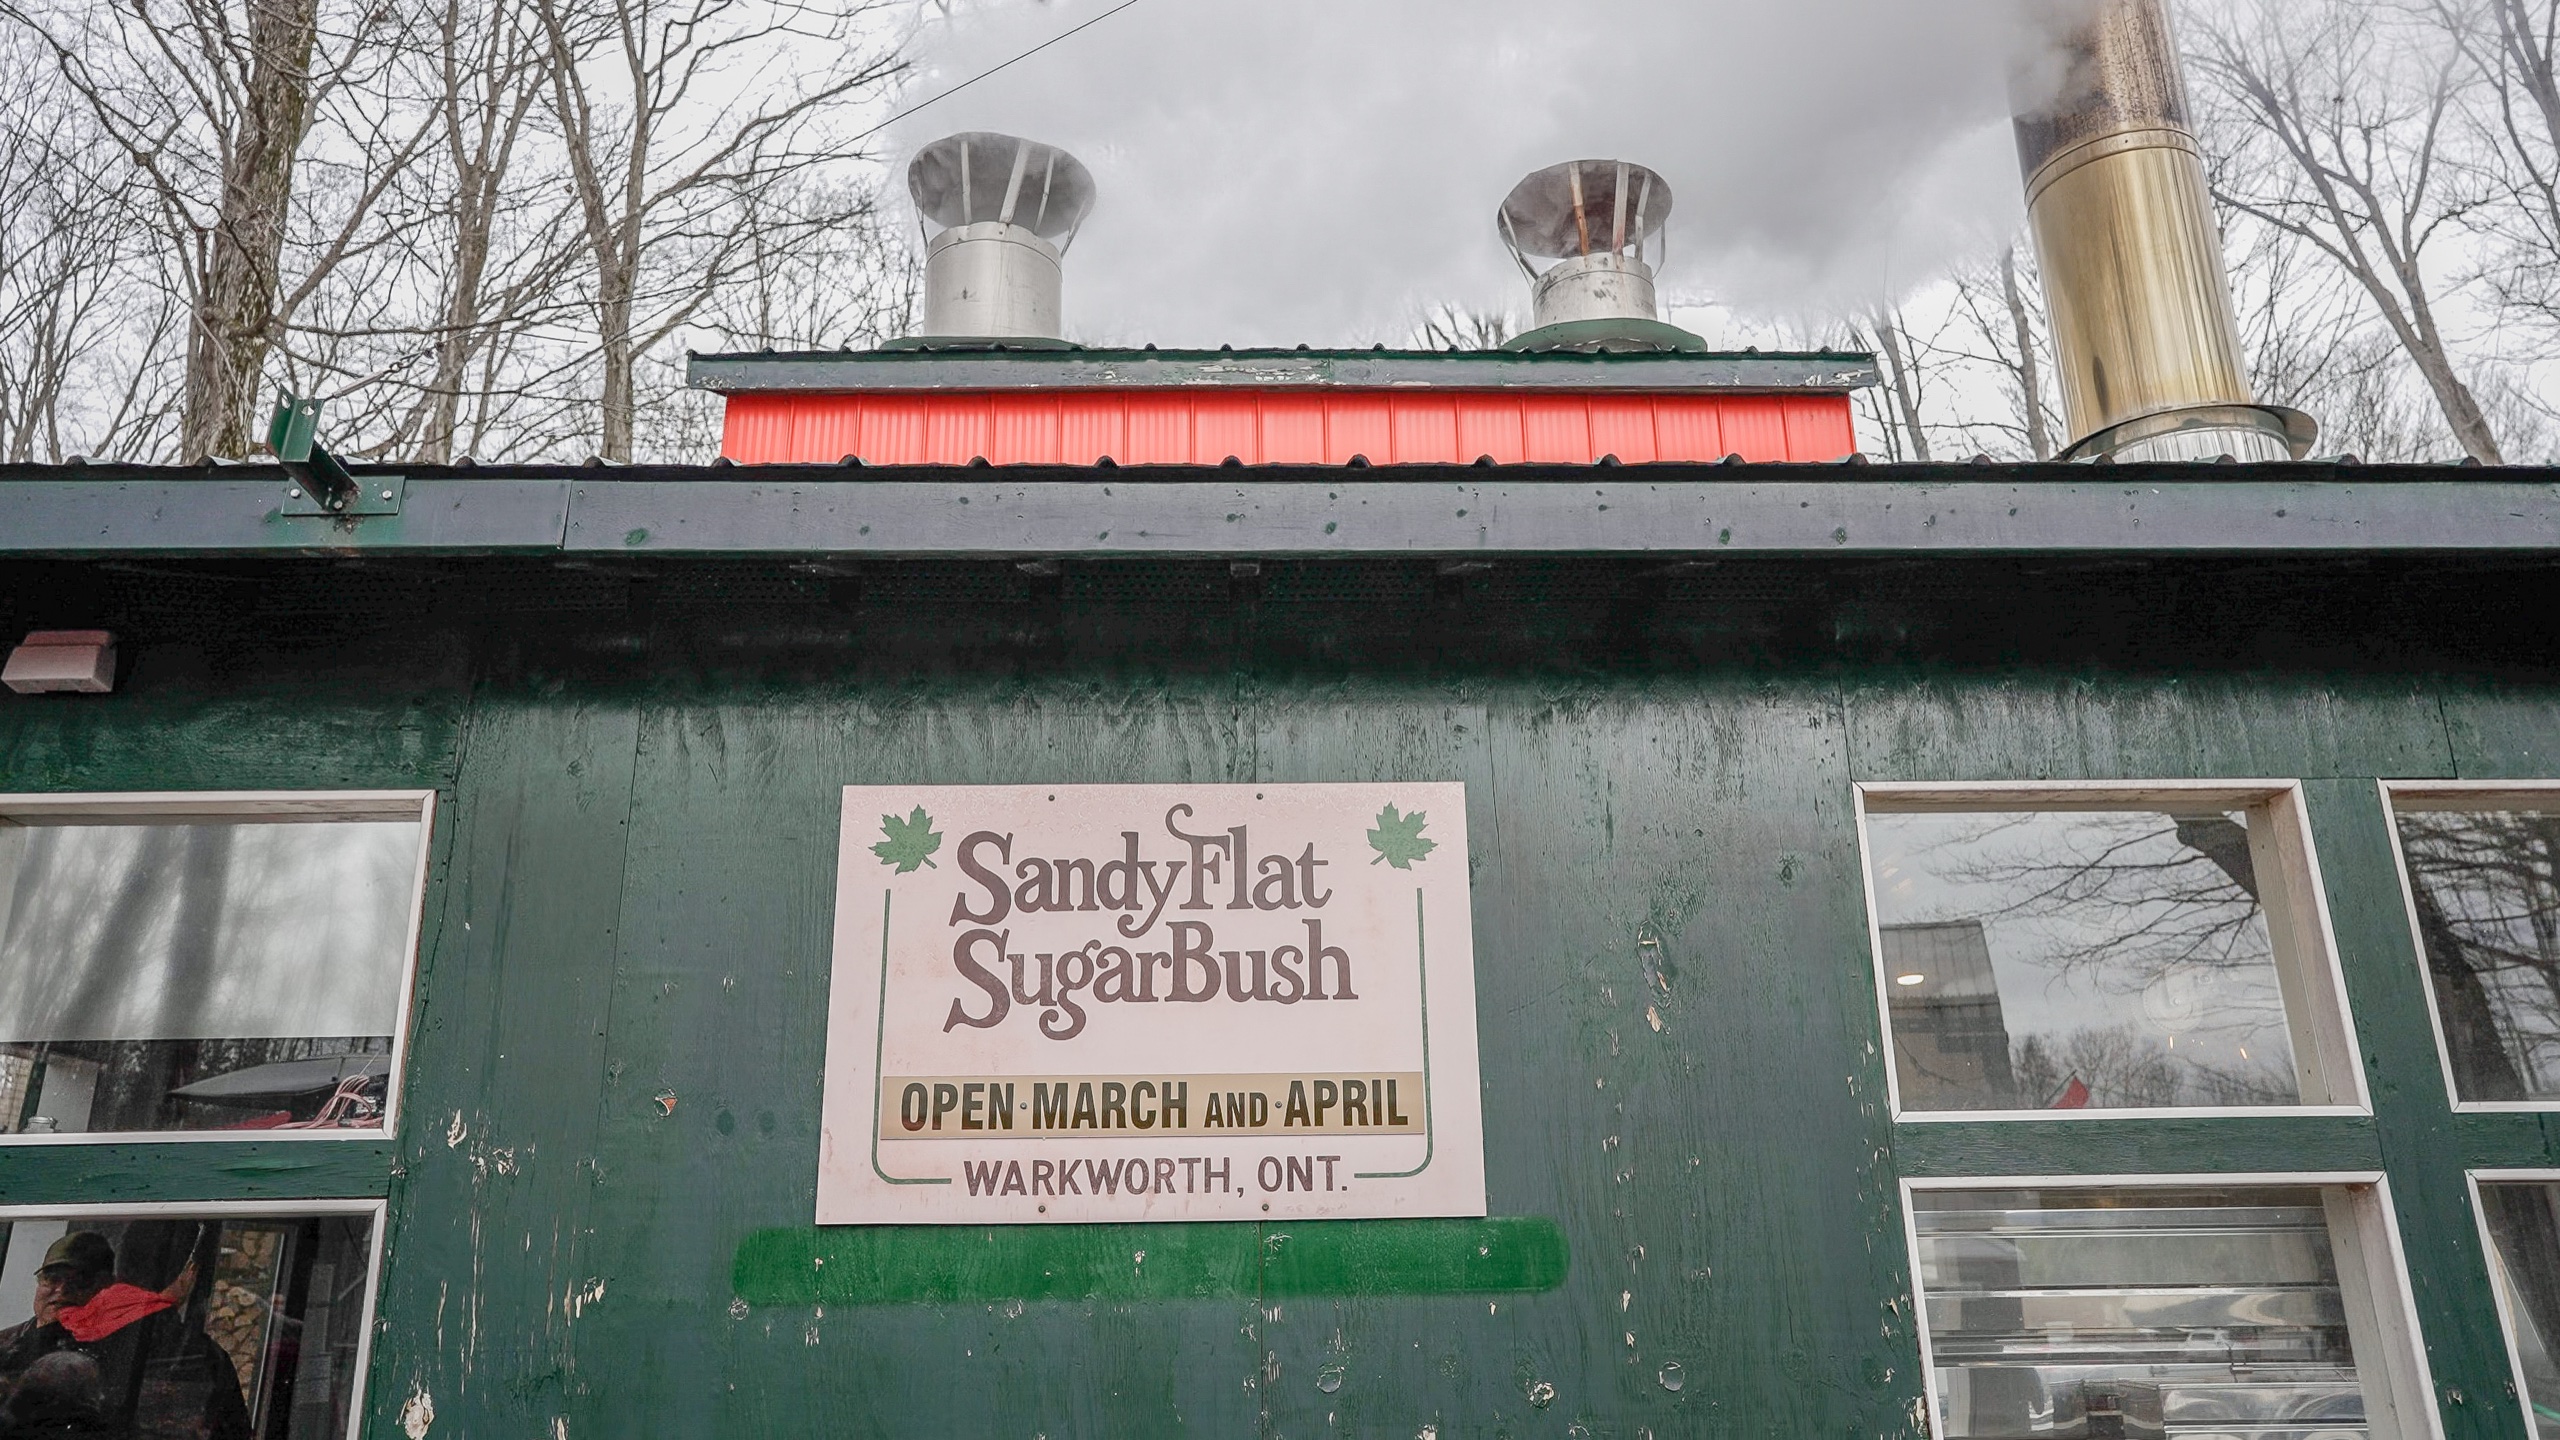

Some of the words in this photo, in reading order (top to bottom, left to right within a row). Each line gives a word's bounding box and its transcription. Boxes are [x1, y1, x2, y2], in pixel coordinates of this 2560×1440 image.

[900, 1082, 1014, 1131] OPEN
[1032, 1080, 1187, 1130] MARCH
[1203, 1092, 1268, 1128] AND
[1283, 1079, 1409, 1128] APRIL
[963, 1156, 1244, 1198] WARKWORTH,
[1257, 1155, 1348, 1193] ONT.
